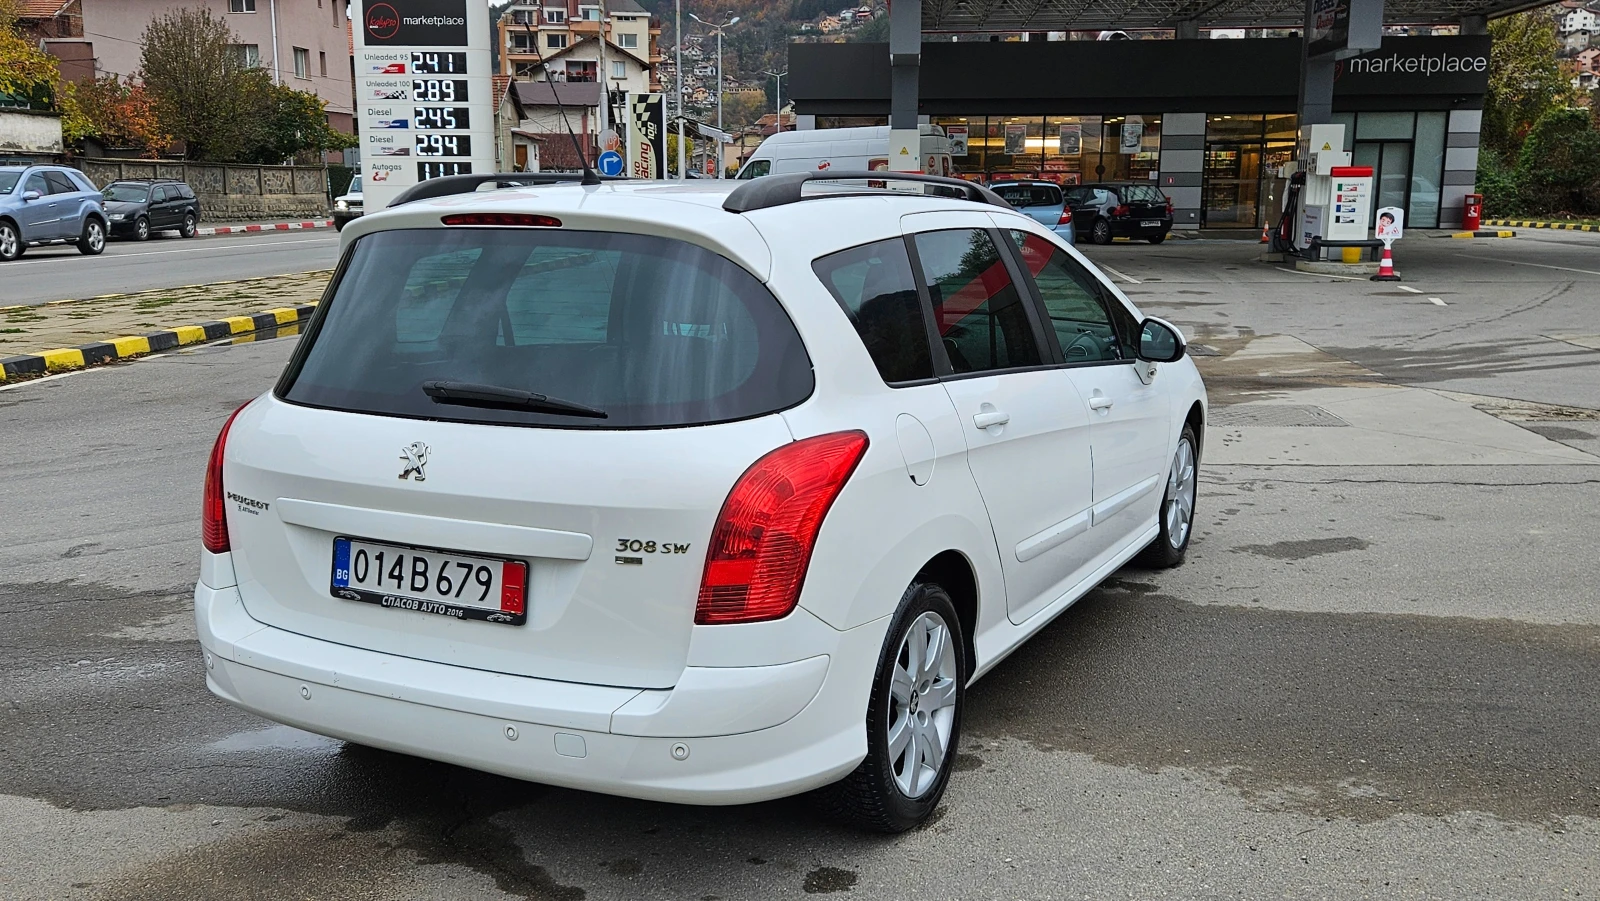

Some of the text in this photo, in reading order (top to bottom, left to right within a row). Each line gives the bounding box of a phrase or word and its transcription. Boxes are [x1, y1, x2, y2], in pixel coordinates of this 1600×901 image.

[403, 16, 464, 27] marketplace
[1350, 53, 1487, 76] marketplace
[368, 108, 392, 116] Diesel
[647, 122, 655, 140] 100
[640, 142, 652, 179] acing
[227, 491, 270, 511] PEUGEOT
[615, 538, 691, 554] 308 SW
[336, 568, 348, 580] BG
[382, 596, 463, 617] СПАСОВ АУТО 2016
